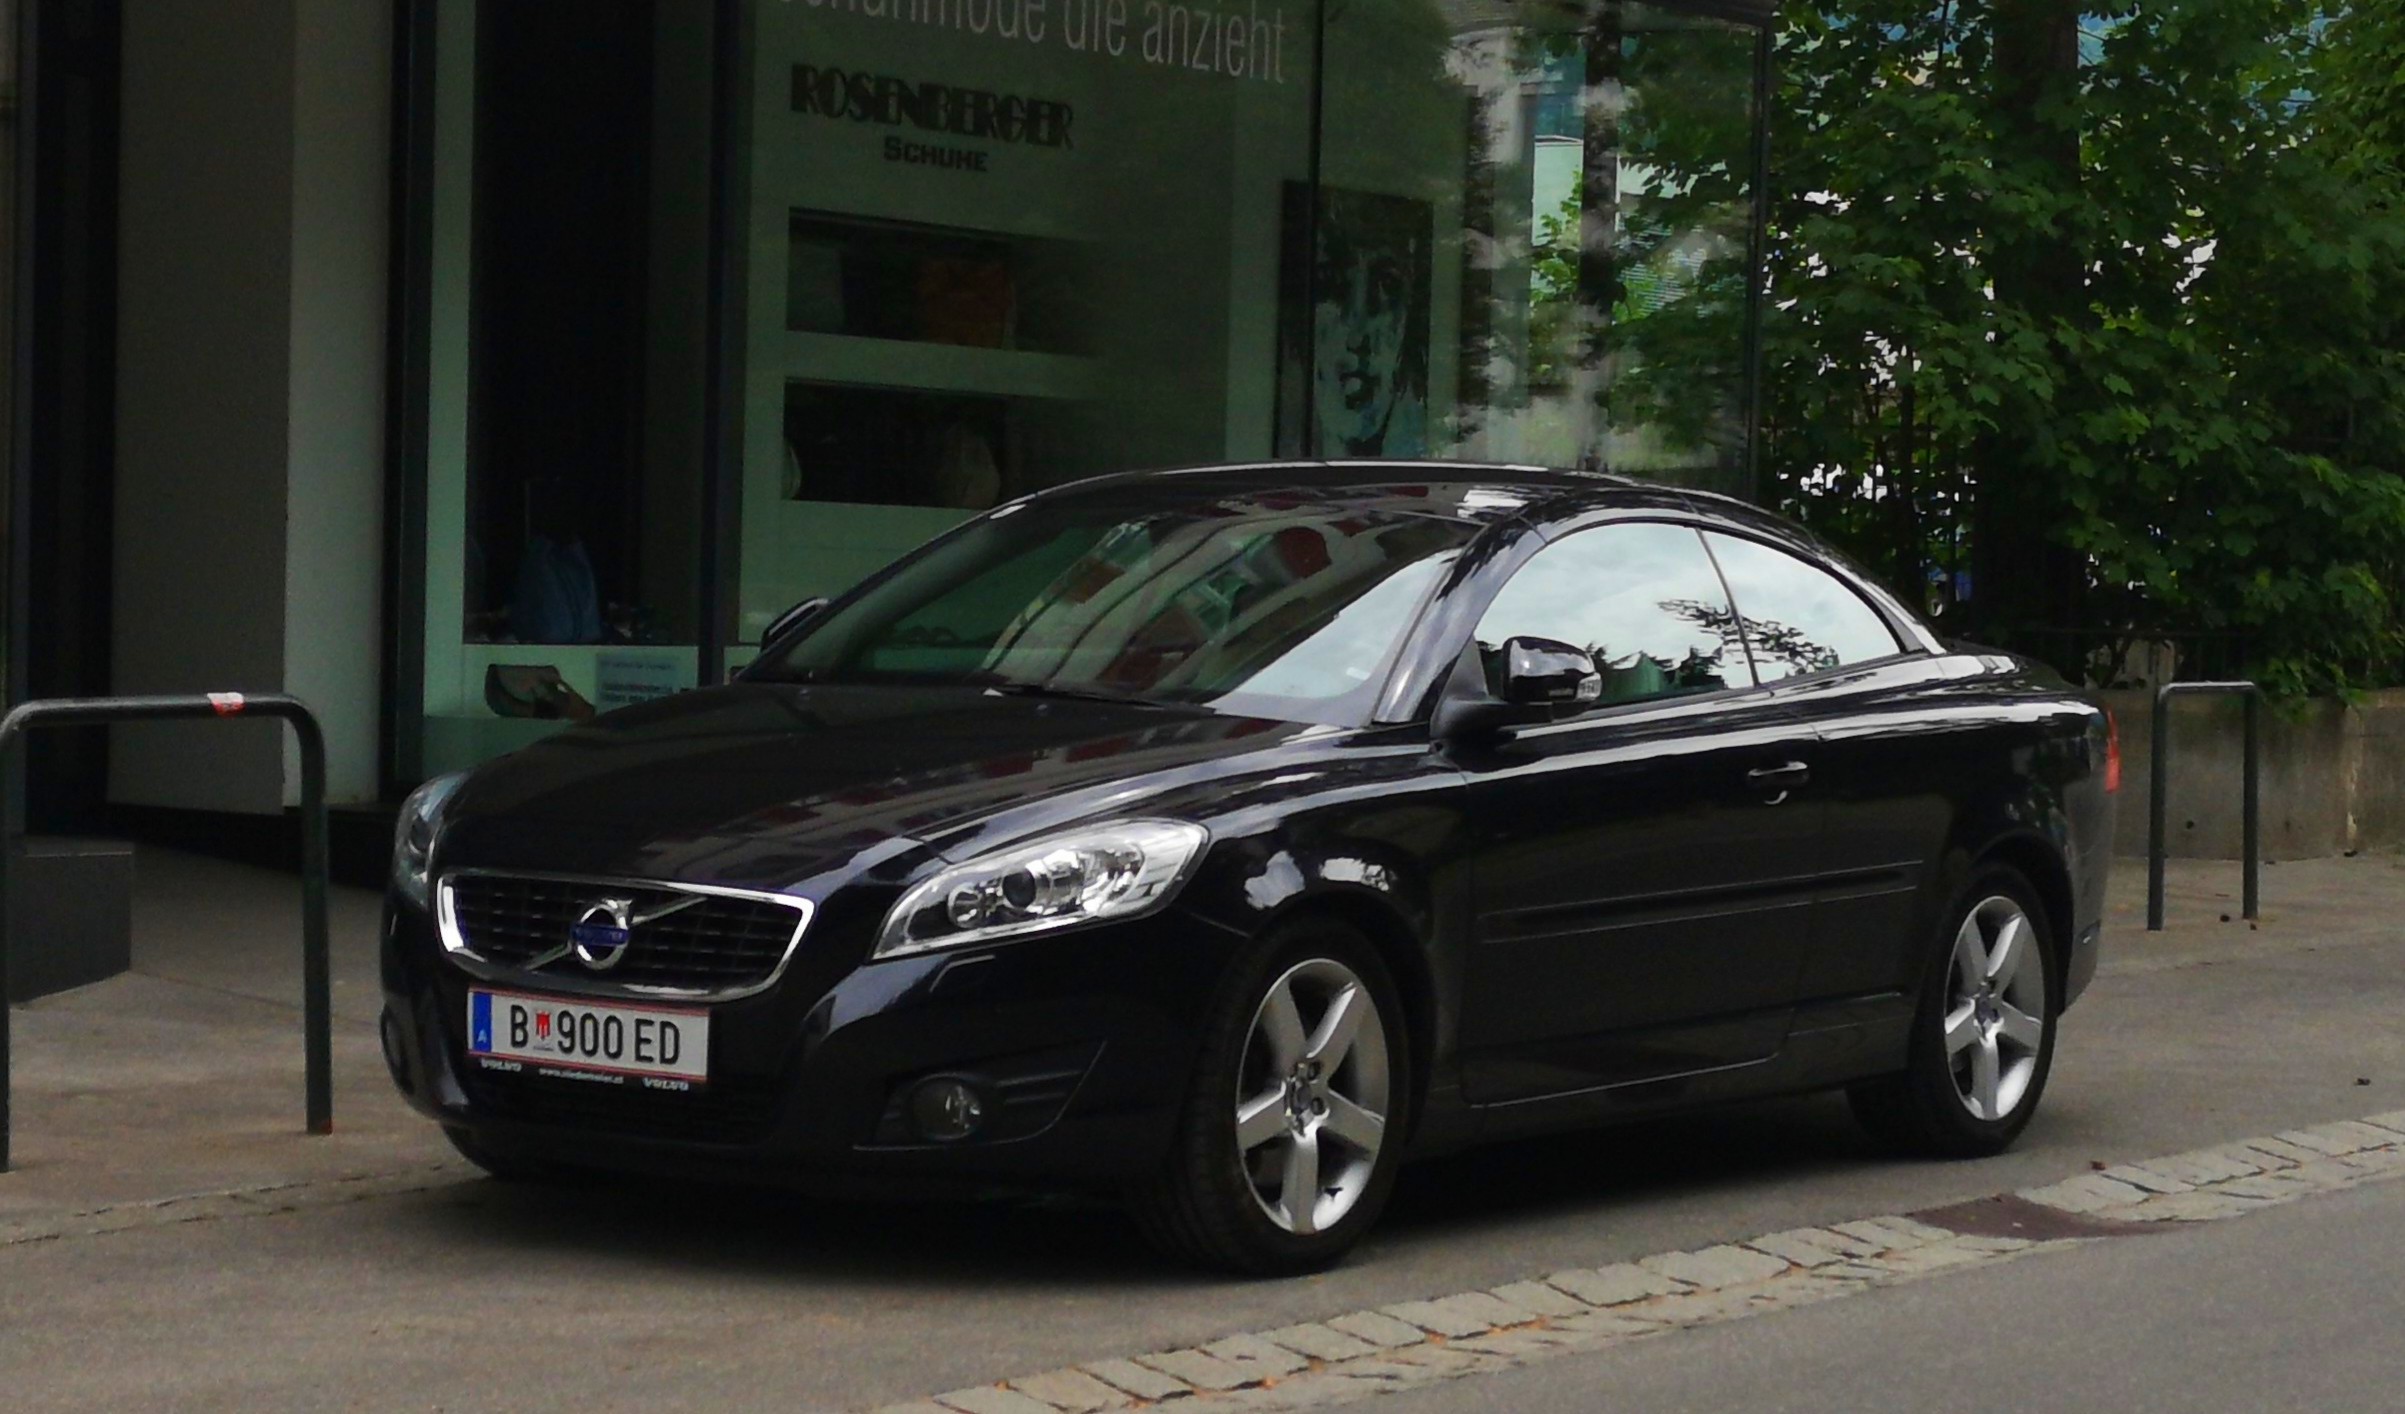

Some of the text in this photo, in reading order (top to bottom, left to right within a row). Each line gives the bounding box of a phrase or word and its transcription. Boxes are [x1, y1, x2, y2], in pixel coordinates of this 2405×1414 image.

[1064, 0, 1126, 56] die
[1142, 0, 1286, 84] anzieht
[791, 64, 1074, 150] ROSENBERGER
[477, 1029, 487, 1043] A
[510, 1004, 680, 1065] B 900 ED
